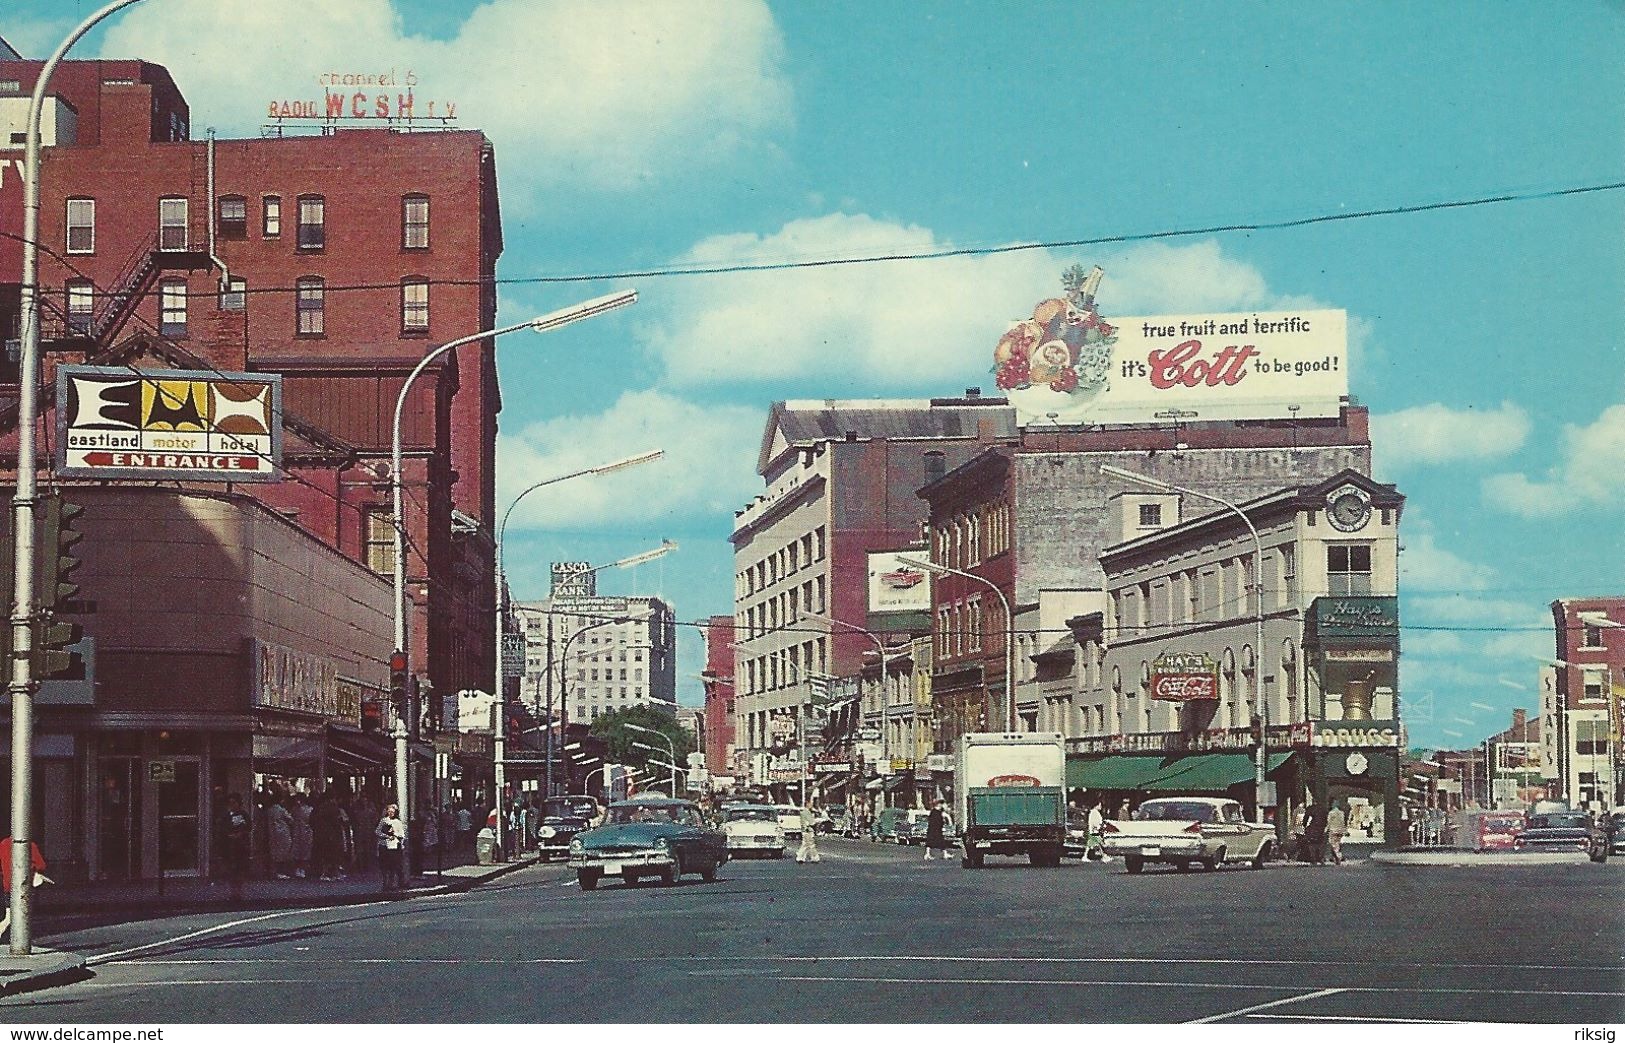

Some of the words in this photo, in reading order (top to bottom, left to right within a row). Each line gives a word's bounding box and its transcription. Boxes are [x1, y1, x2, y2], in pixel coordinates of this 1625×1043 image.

[319, 67, 396, 86] channel
[325, 91, 416, 119] WCSH
[1142, 322, 1176, 338] true
[1179, 320, 1217, 336] fruit
[1219, 319, 1248, 335] and
[1252, 316, 1311, 334] terrific
[1121, 360, 1147, 378] it's
[1147, 339, 1261, 390] Cott
[1253, 358, 1271, 374] to
[1273, 358, 1292, 373] be
[69, 433, 139, 448] eastland
[152, 437, 197, 449] motor
[219, 437, 260, 451] hotel
[112, 453, 241, 470] ENTRANCE
[551, 562, 590, 573] CASCO
[1165, 655, 1203, 667] HAY'S
[1543, 676, 1554, 766] SEARS
[1321, 727, 1395, 746] DRUGS
